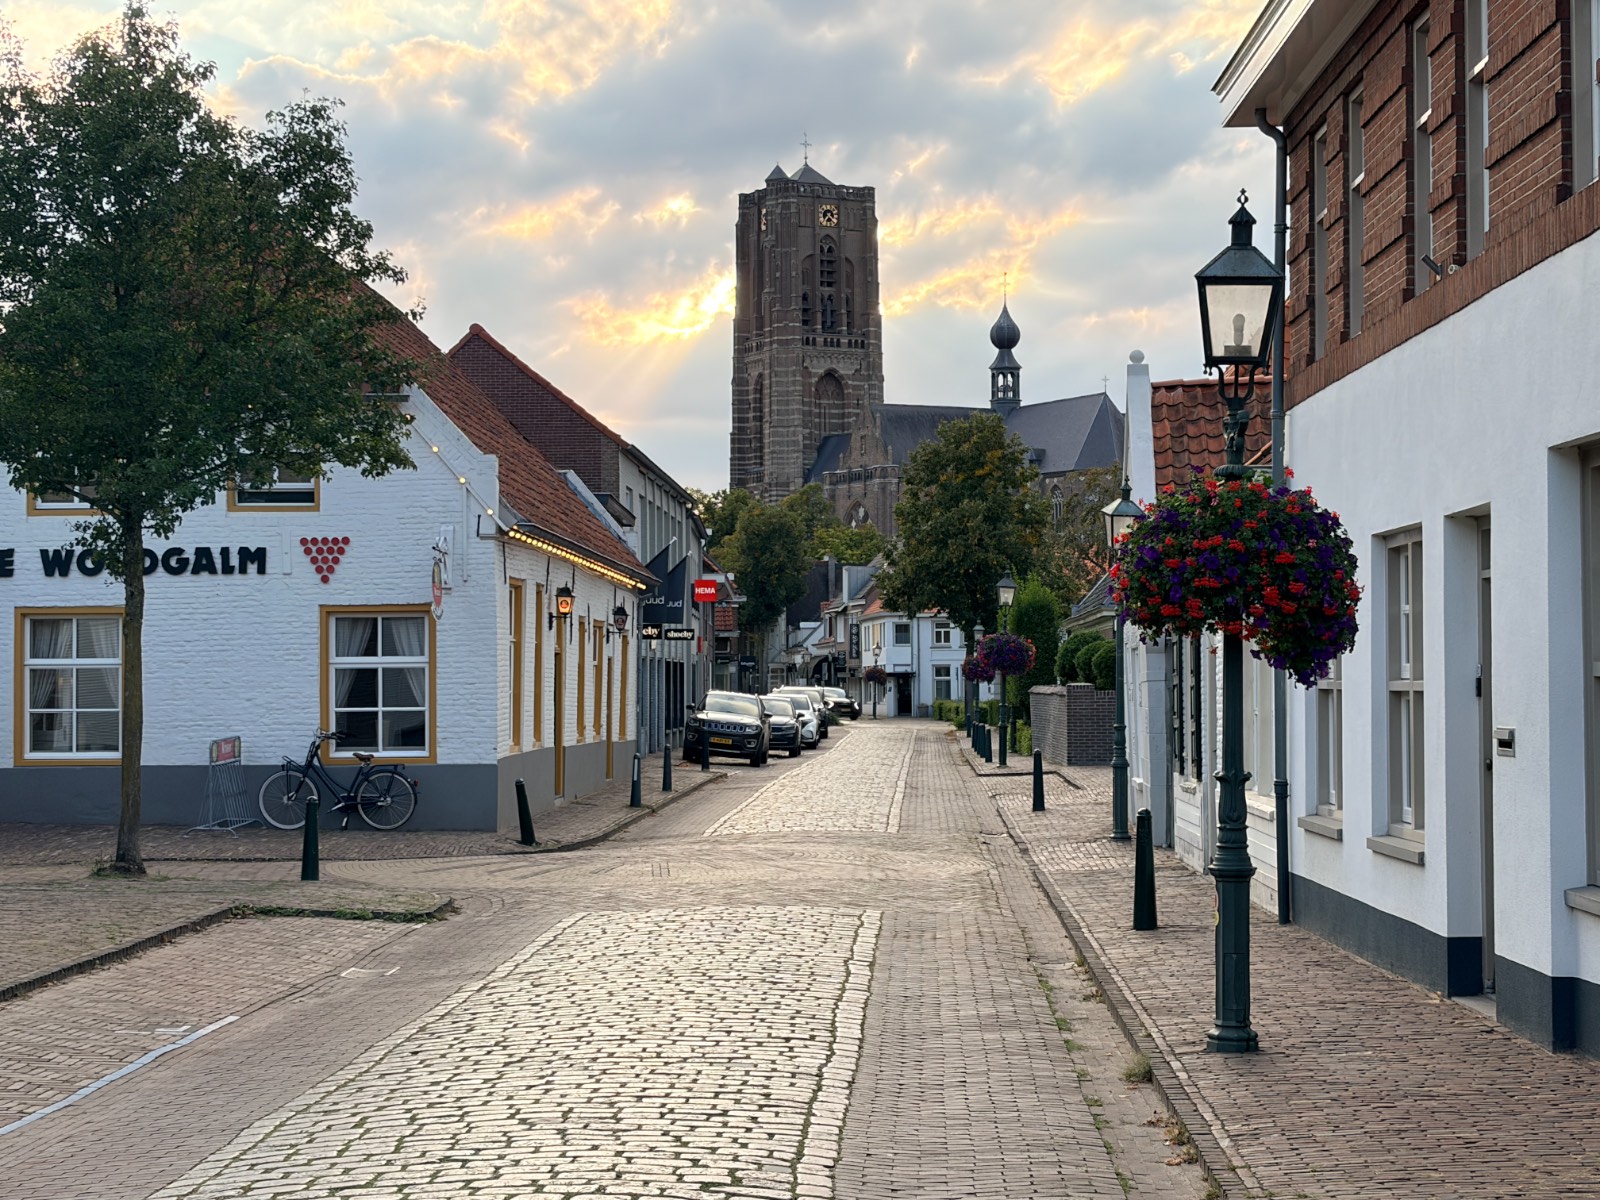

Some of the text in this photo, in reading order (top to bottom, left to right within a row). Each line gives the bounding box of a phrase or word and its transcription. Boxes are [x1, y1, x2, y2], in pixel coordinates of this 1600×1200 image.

[39, 547, 267, 577] WODGALM
[642, 627, 660, 637] eby
[667, 631, 694, 639] shoeby
